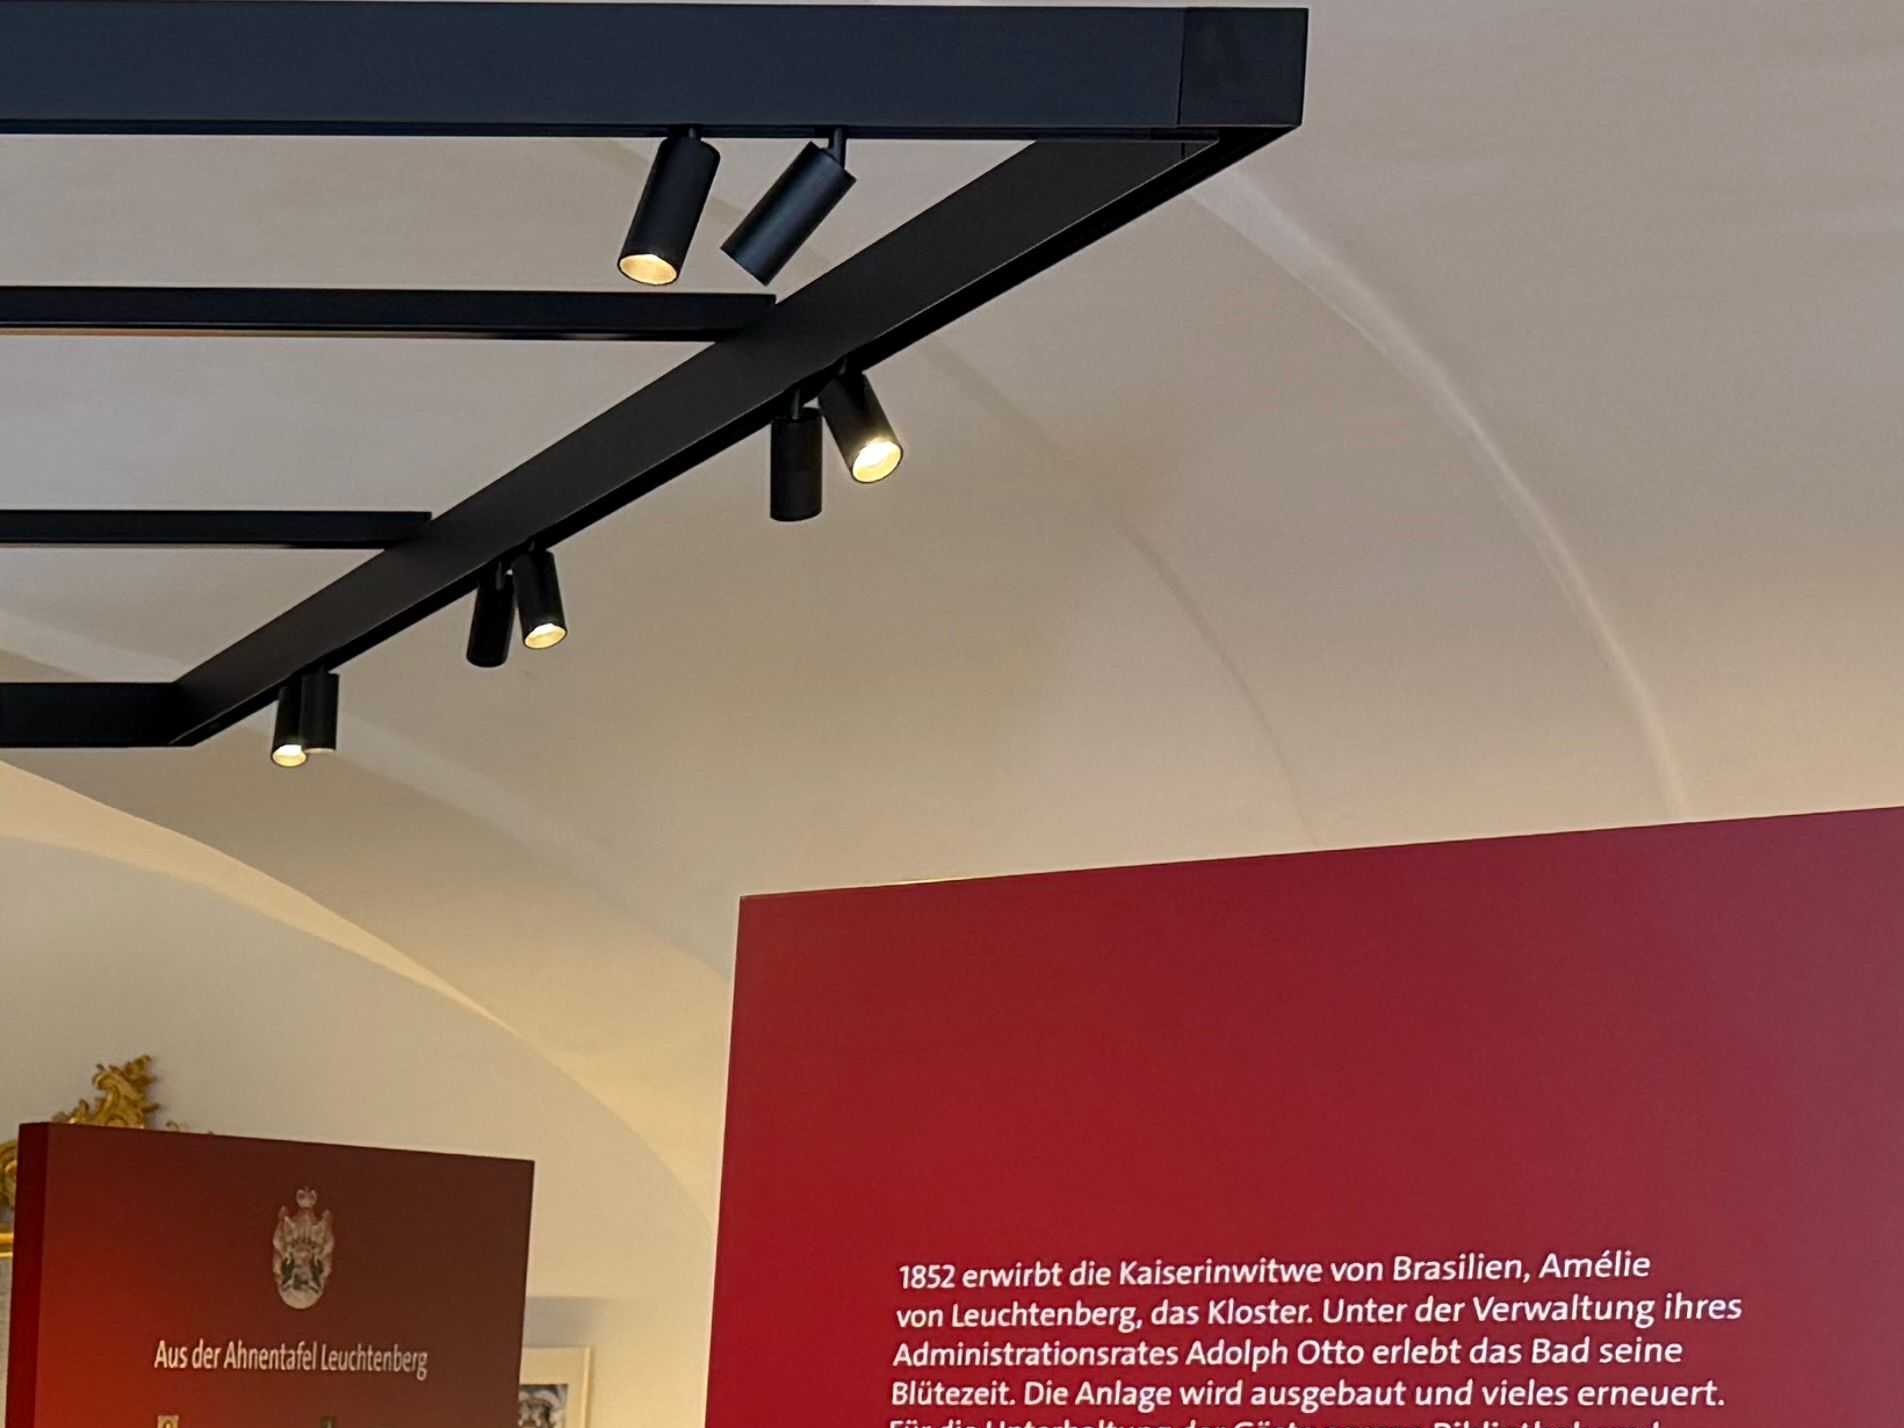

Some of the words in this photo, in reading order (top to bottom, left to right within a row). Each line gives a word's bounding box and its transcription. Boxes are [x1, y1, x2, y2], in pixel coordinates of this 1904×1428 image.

[900, 1265, 955, 1288] 1852
[963, 1262, 1062, 1287] erwirbt
[1070, 1261, 1111, 1285] die
[1120, 1258, 1322, 1285] Kaiserinwitwe
[1331, 1263, 1383, 1281] von
[1394, 1253, 1530, 1283] Brasilien,
[1539, 1250, 1650, 1278] Amélie
[897, 1310, 943, 1327] von
[952, 1301, 1142, 1333] Leuchtenberg,
[1152, 1299, 1199, 1324] das
[1208, 1298, 1312, 1324] Kloster.
[1324, 1298, 1407, 1323] Unter
[1415, 1296, 1465, 1322] der
[1473, 1294, 1655, 1328] Verwaltung
[1665, 1292, 1741, 1319] ihres
[154, 1340, 188, 1368] Aus
[192, 1339, 221, 1368] der
[224, 1340, 317, 1370] Ahnentafel
[321, 1344, 427, 1380] Leuchtenberg
